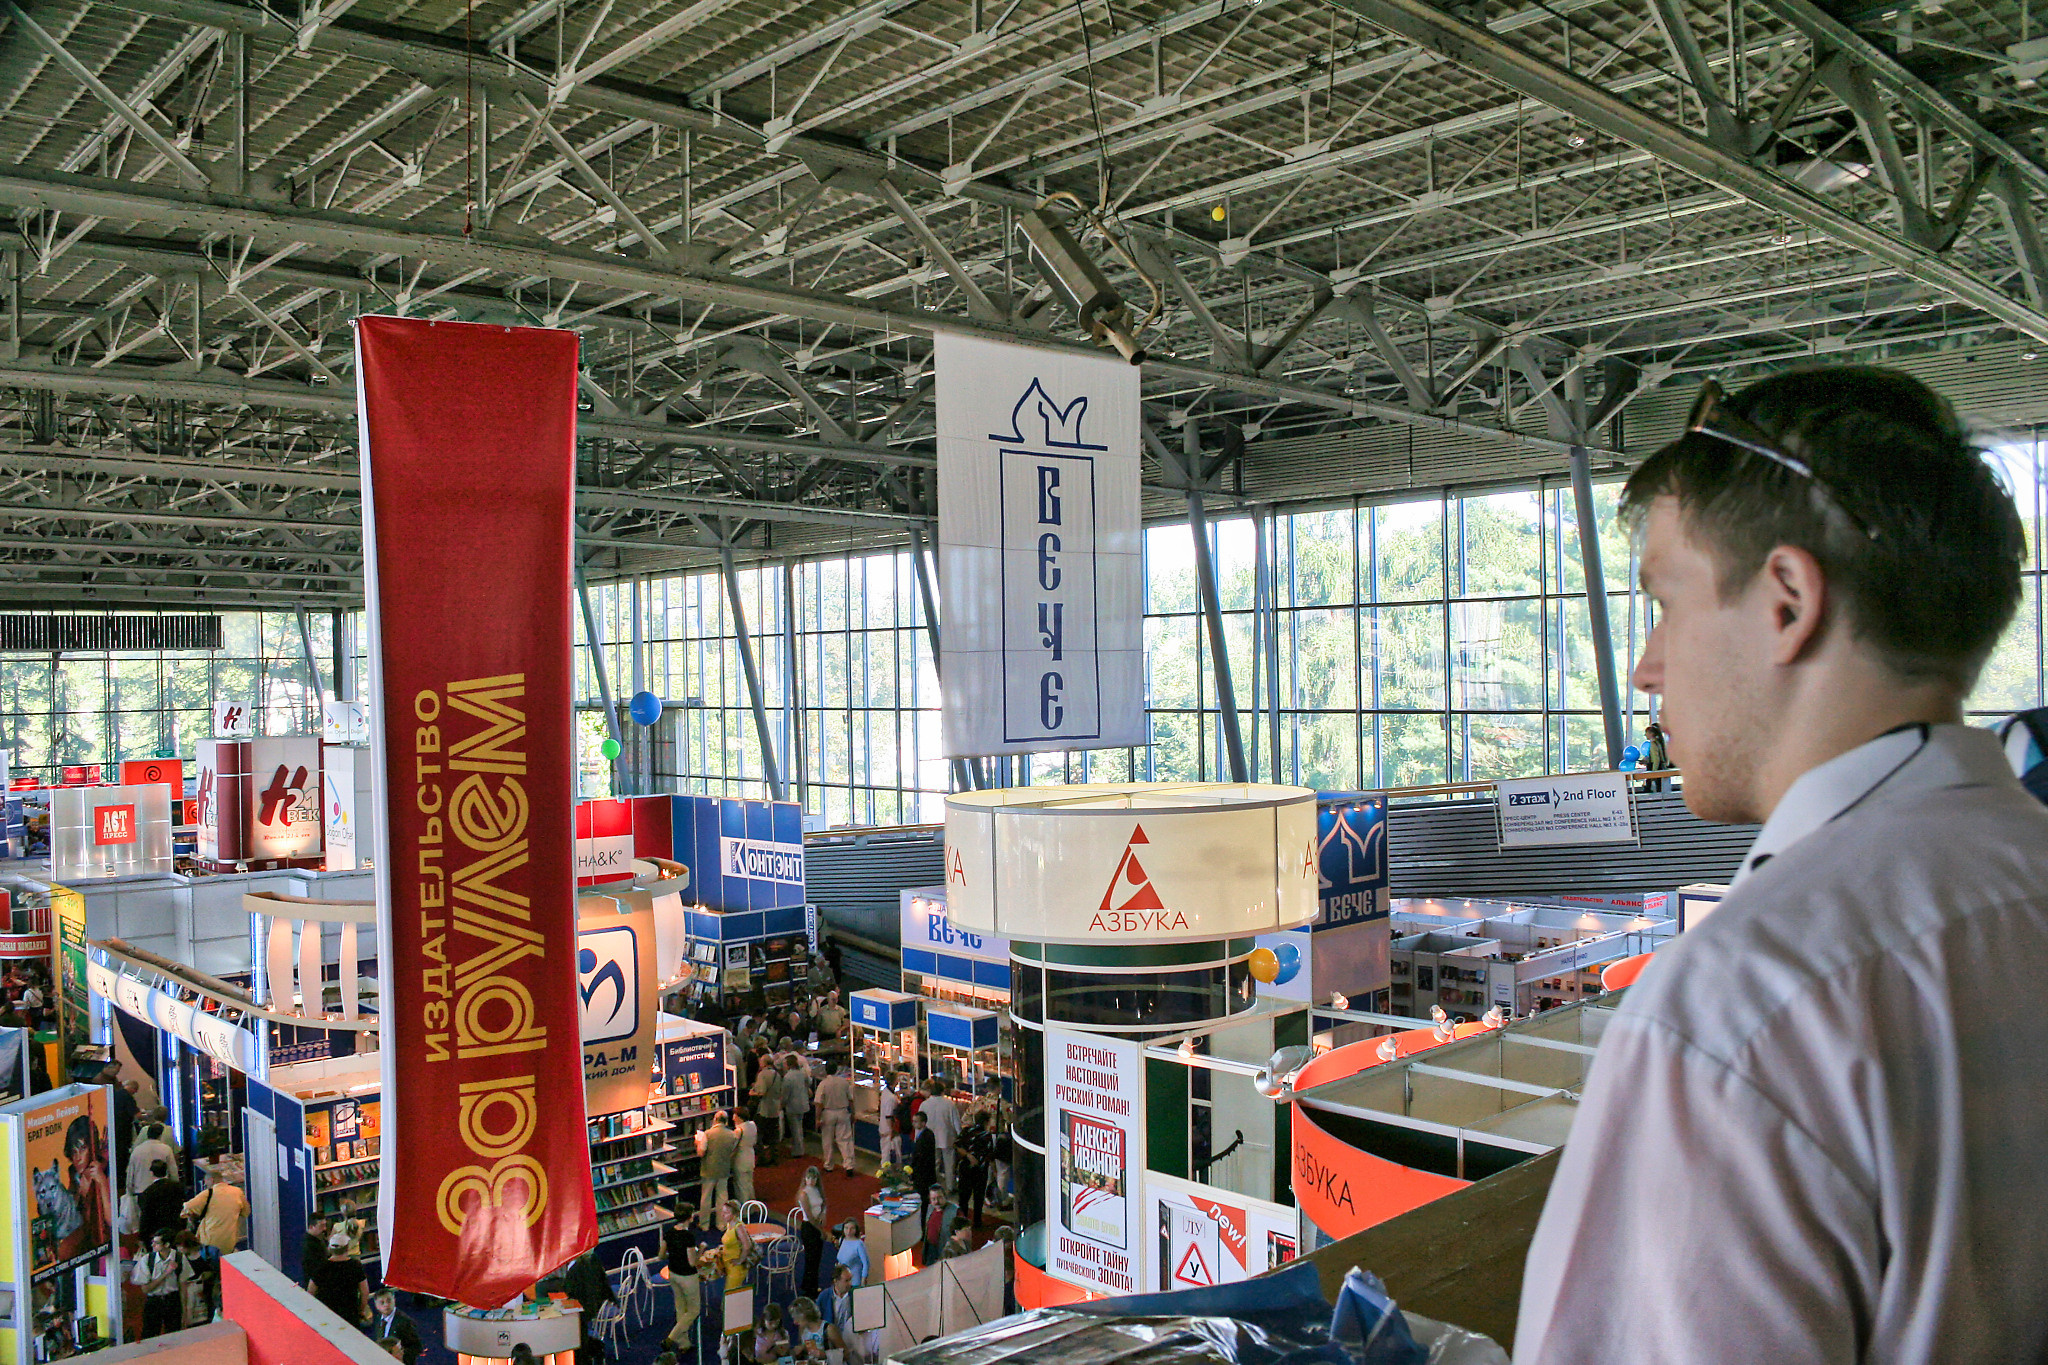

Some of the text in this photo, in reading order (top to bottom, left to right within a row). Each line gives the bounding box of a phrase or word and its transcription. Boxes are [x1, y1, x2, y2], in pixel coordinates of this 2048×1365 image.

[1037, 465, 1064, 730] ВЕЧЕ
[286, 787, 320, 810] 21
[1510, 793, 1546, 805] 2 этаж
[1563, 788, 1617, 801] 2nd Floor
[103, 810, 128, 832] АСТ
[286, 809, 320, 823] ВЕК
[1554, 823, 1589, 831] CONFERENCE
[414, 689, 453, 1062] ИЗДАТЕЛЬСТВО
[1330, 890, 1373, 922] ВЕЧЕ
[1610, 899, 1643, 908] АЛЬЯНС
[1088, 911, 1189, 932] АЗБУКА
[17, 940, 48, 951] КОМПАНИЯ
[1066, 1043, 1117, 1069] ВСТРЕЧАЙТЕ
[1065, 1064, 1119, 1092] НАСТОЯЩИЙ
[1055, 1083, 1130, 1117] РУССКИЙ РОМАН!
[27, 1121, 62, 1142] БРАТ ВОЛК
[1074, 1122, 1120, 1156] АЛЕКСЕЙ
[436, 1074, 548, 1236] За
[1074, 1145, 1121, 1180] ИВАНОВ
[1209, 1203, 1247, 1249] new!
[1060, 1236, 1129, 1273] ОТКРОЙТЕ ТАЙНУ
[1097, 1266, 1133, 1293] ЗОЛОТА!
